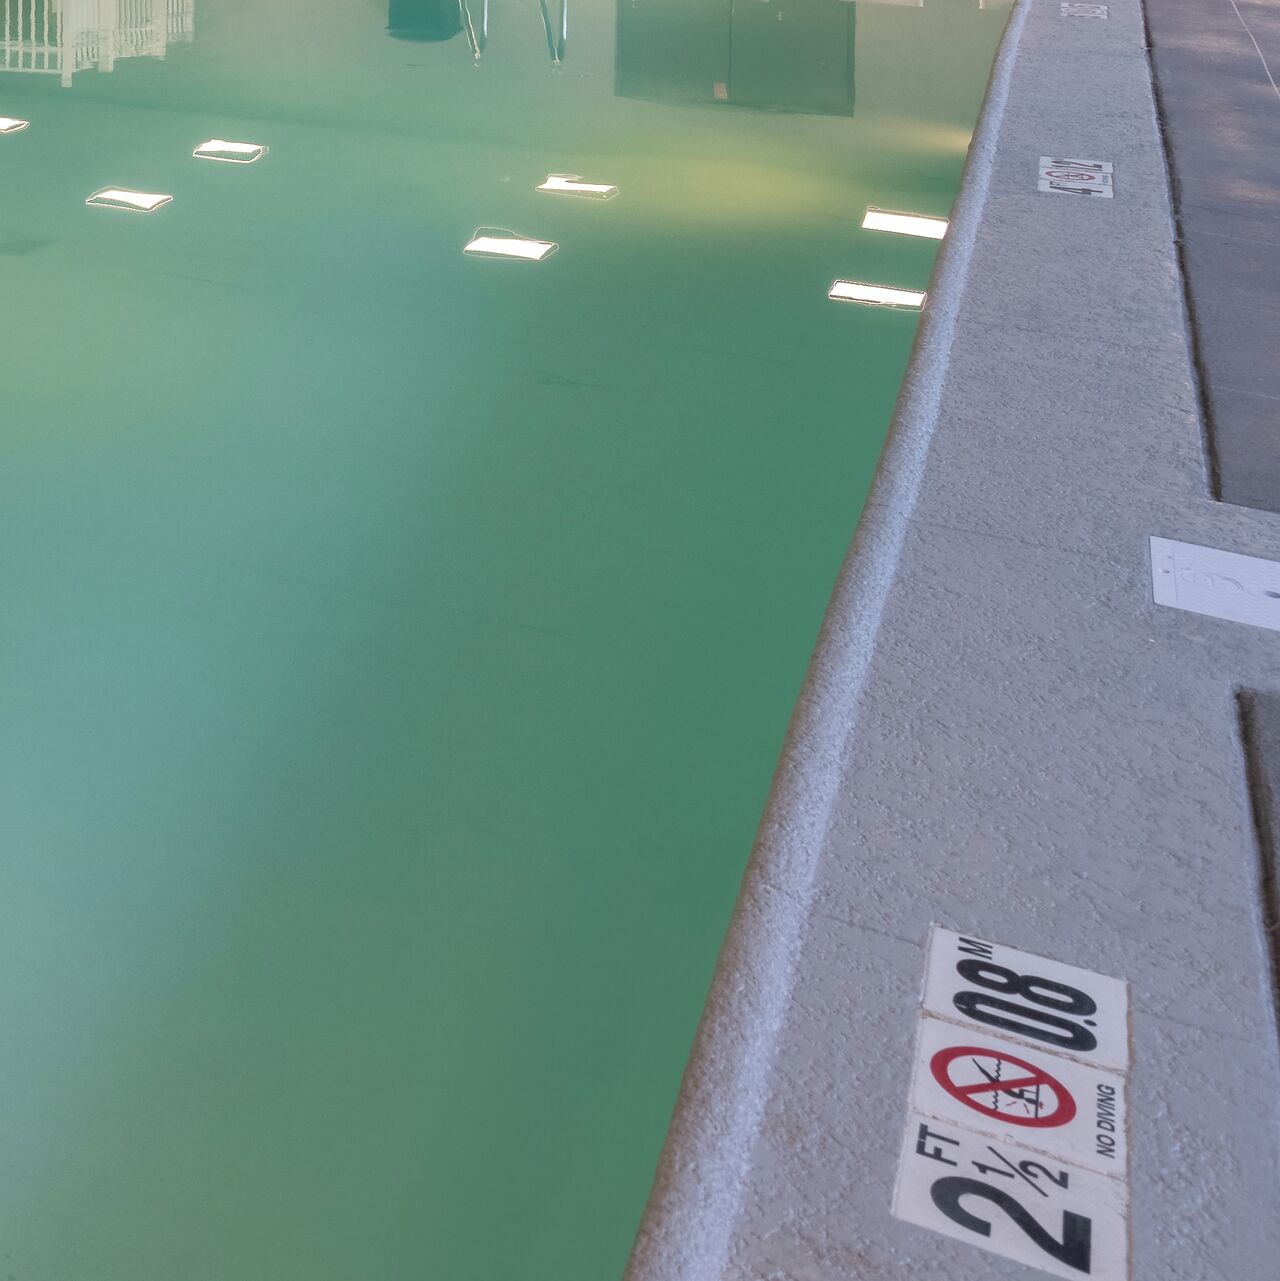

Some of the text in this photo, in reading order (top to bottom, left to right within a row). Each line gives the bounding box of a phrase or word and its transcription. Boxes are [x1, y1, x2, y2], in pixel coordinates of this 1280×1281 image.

[957, 936, 993, 961] M
[915, 1123, 960, 1168] FT
[1096, 1084, 1116, 1159] NO DIVING
[930, 1175, 1092, 1276] 2
